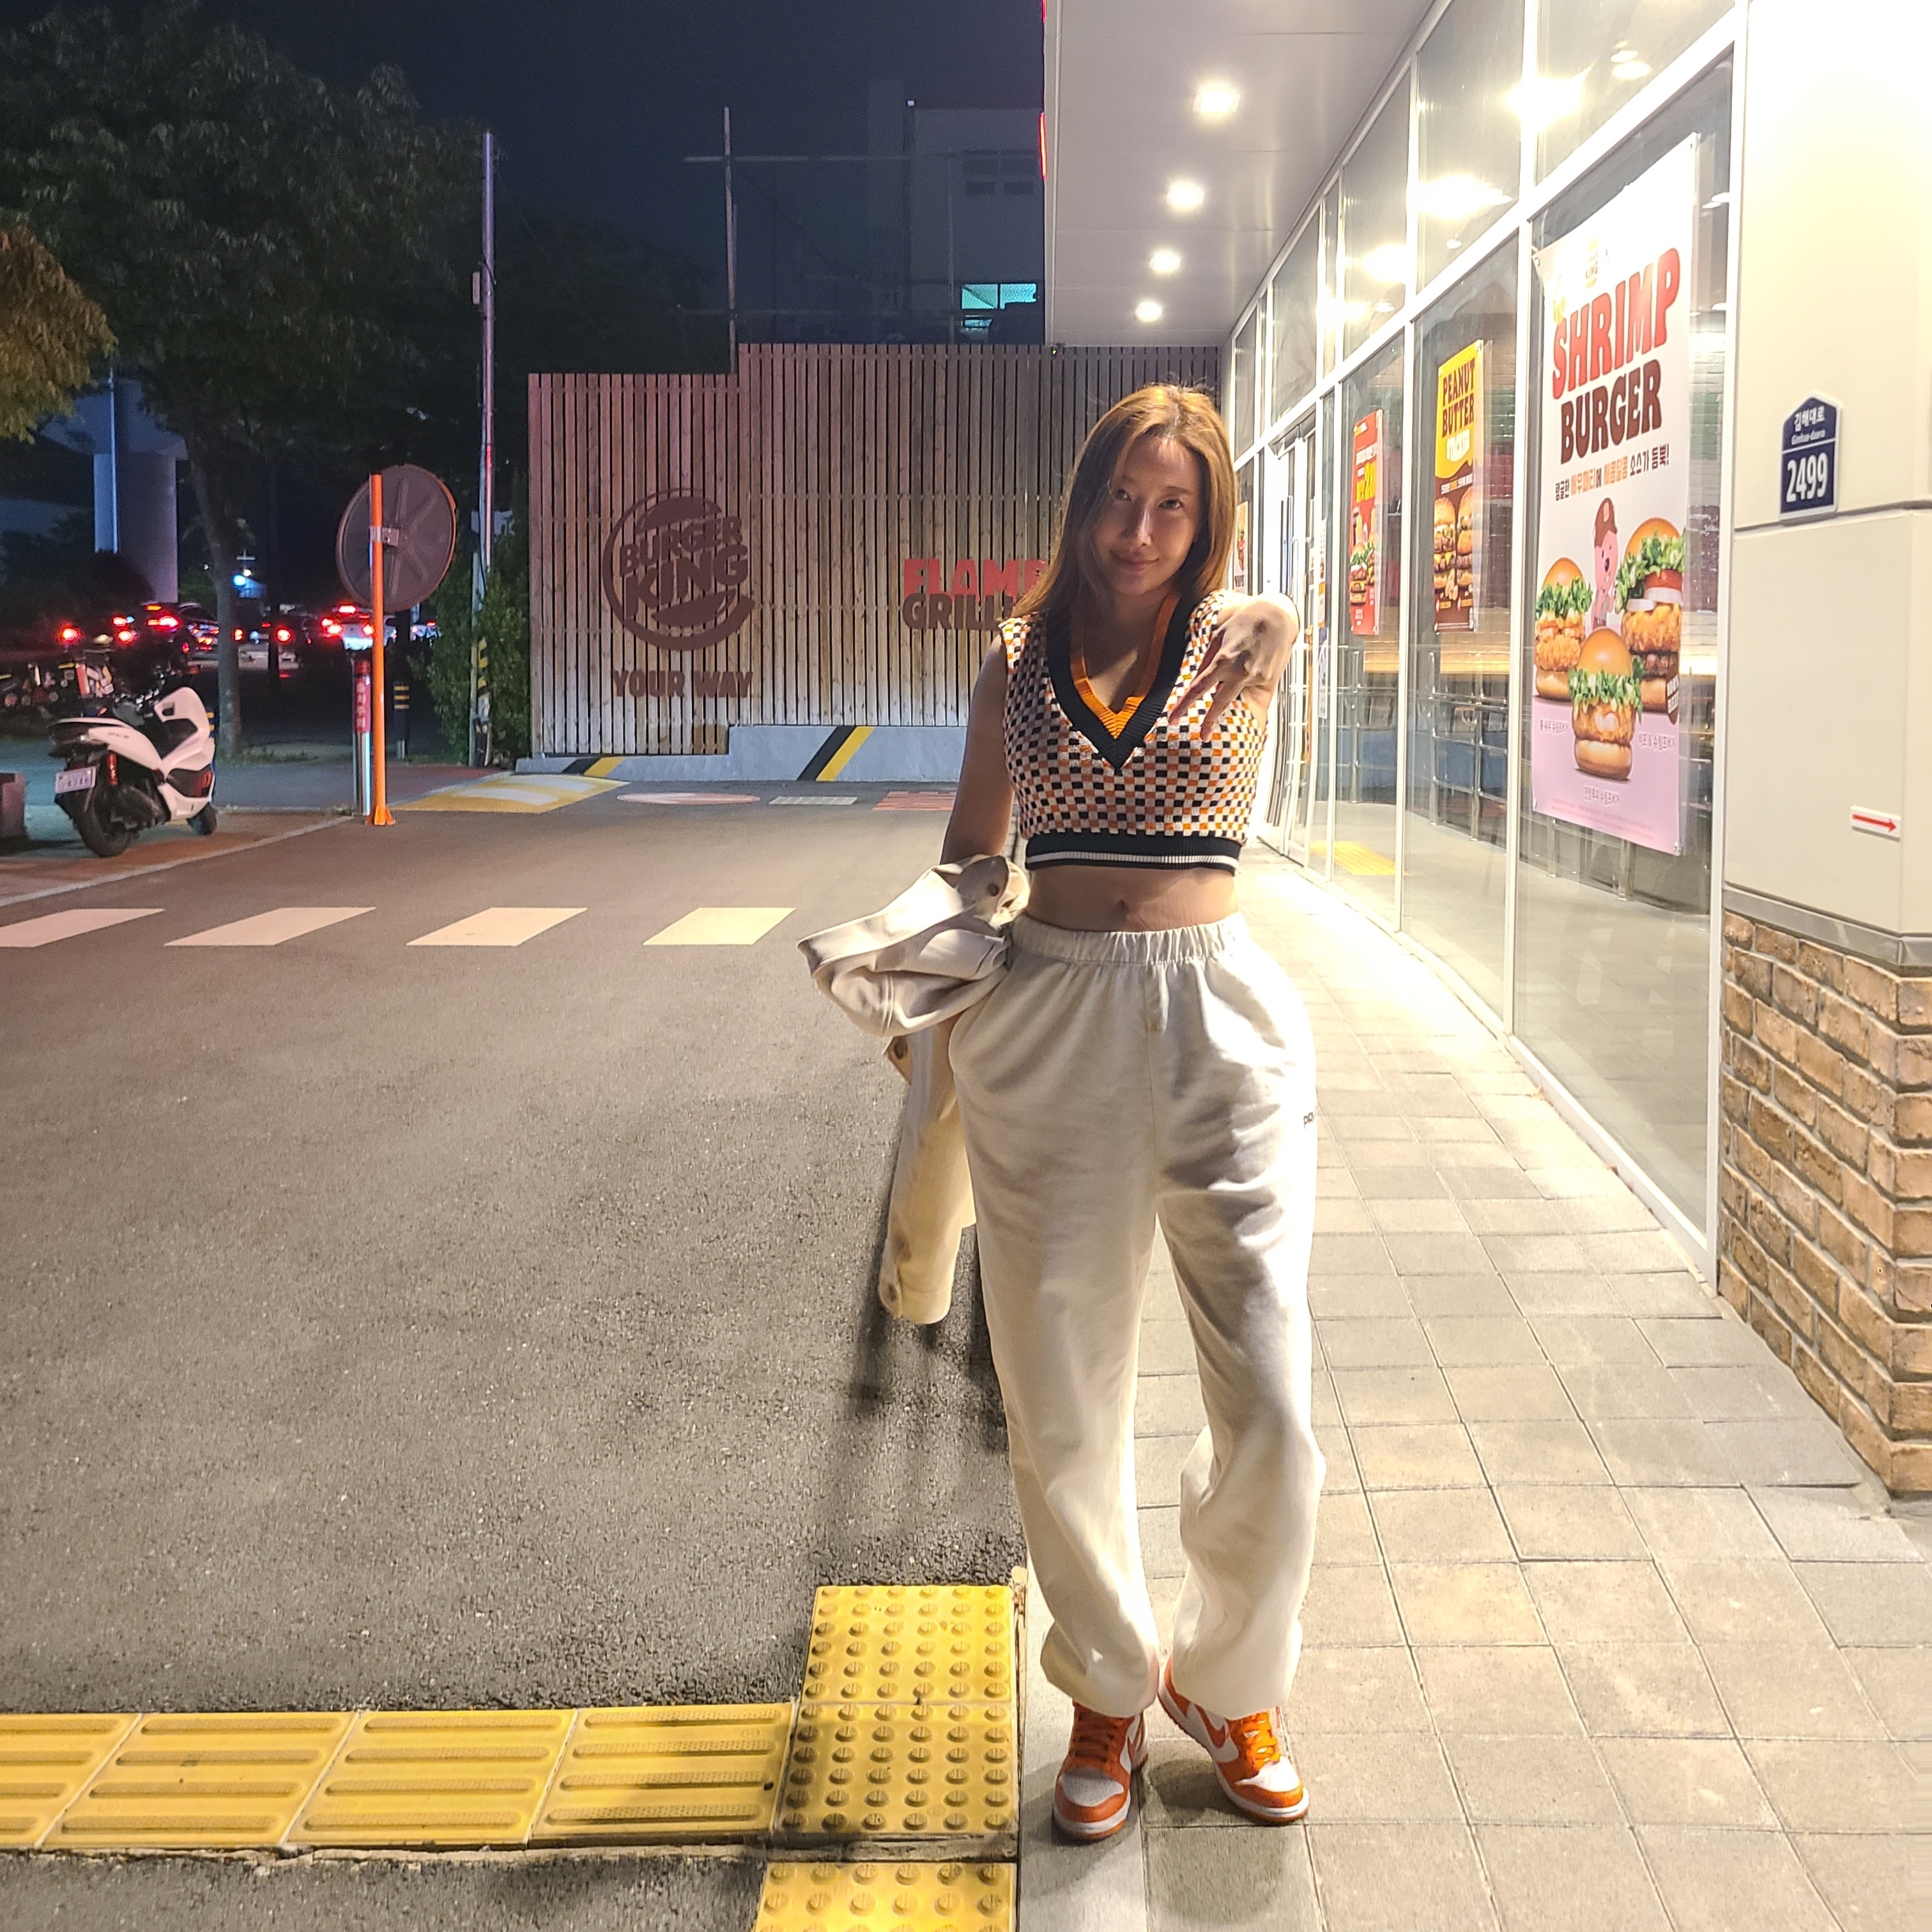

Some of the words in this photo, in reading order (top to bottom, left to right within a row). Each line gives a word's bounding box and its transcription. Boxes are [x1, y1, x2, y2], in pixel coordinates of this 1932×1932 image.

[1552, 248, 1680, 399] SHRIMP
[1443, 357, 1475, 407] PEANUT
[1442, 392, 1474, 438] BUTTER
[1560, 359, 1662, 464] BURGER
[1794, 406, 1825, 433] 김해대로
[1630, 449, 1649, 477] 소스가
[1786, 452, 1828, 503] 2499
[620, 516, 742, 577] BURGER
[625, 544, 748, 618] KING
[613, 671, 685, 697] YOUR
[694, 671, 753, 698] WAY
